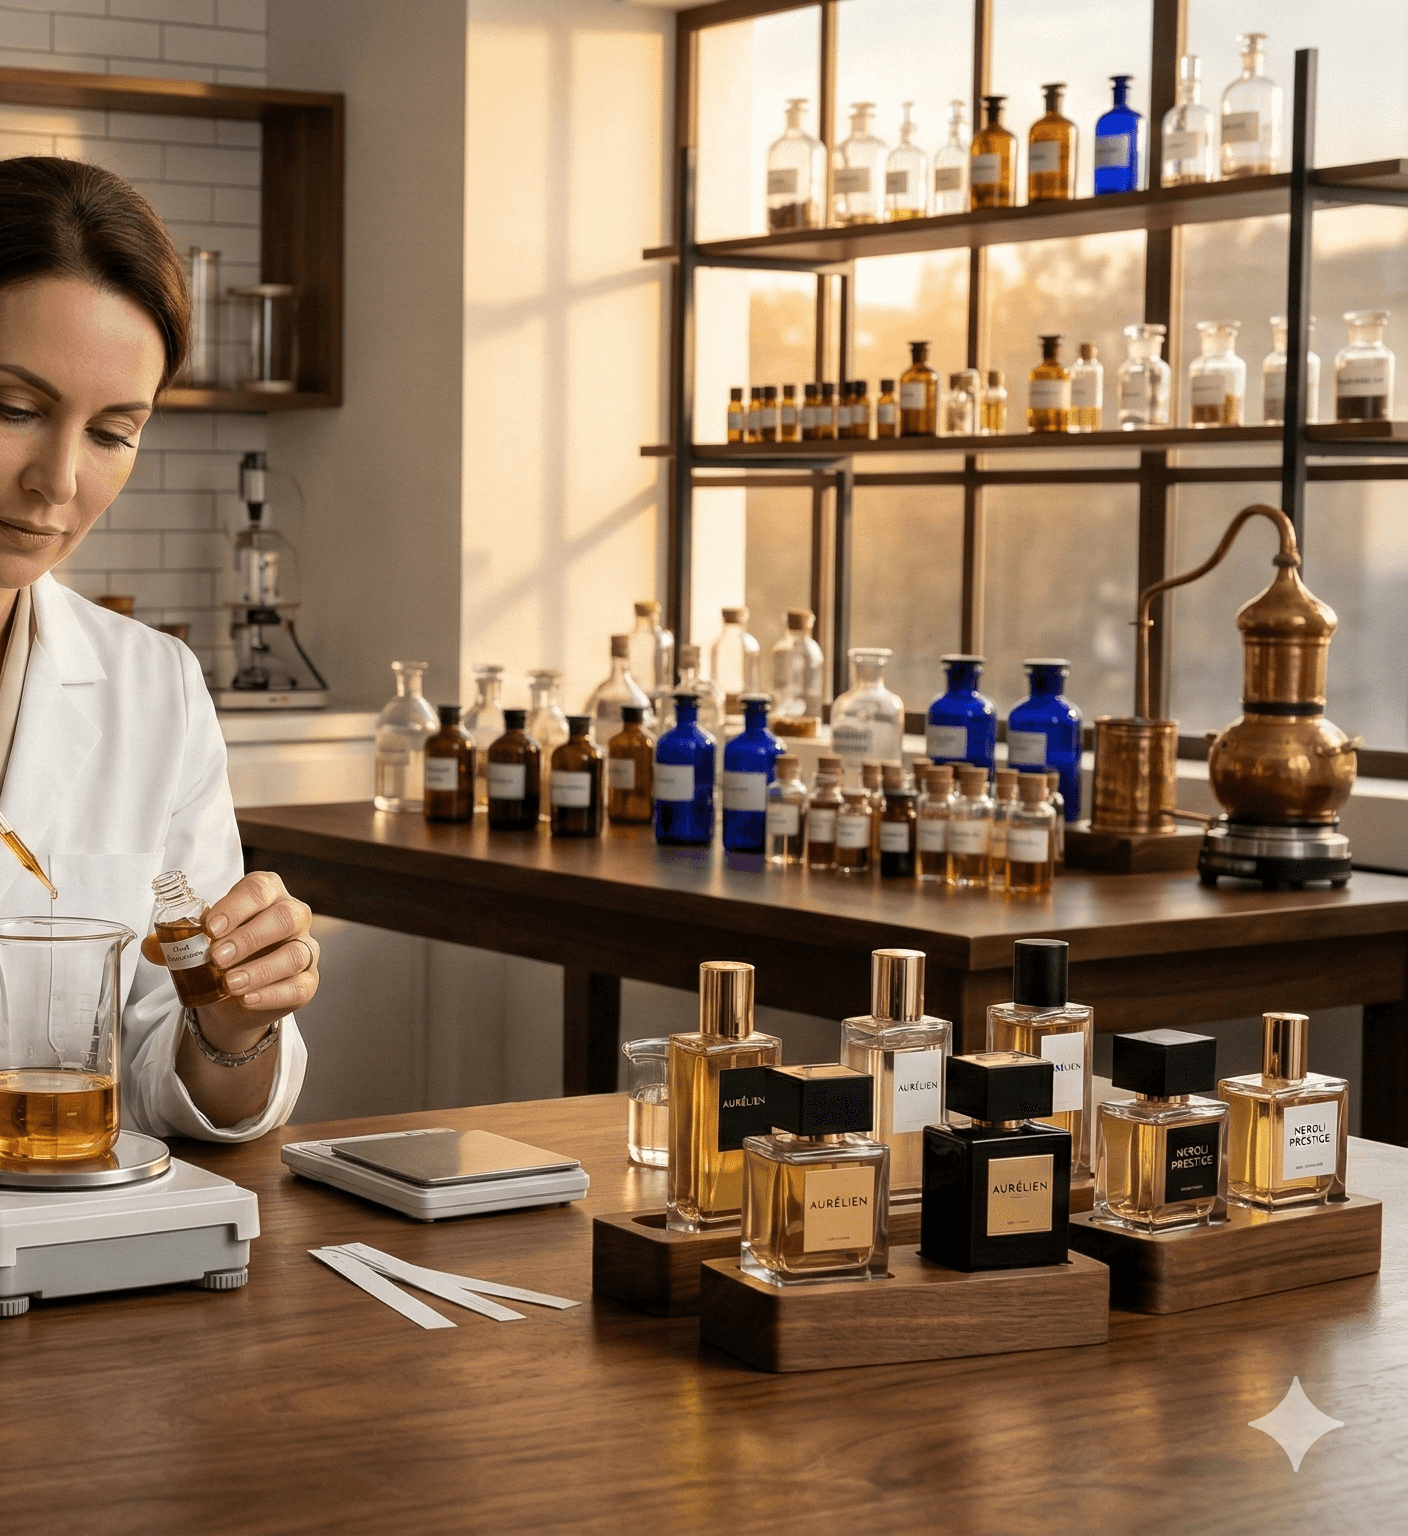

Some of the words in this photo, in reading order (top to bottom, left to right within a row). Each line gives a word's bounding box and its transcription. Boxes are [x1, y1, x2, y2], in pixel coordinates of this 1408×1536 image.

[1294, 1122, 1326, 1136] NEROLI
[1171, 1155, 1214, 1171] PRESTIGE
[992, 1179, 1048, 1194] AURÉLIEN
[809, 1195, 868, 1210] AURÉLIEN
